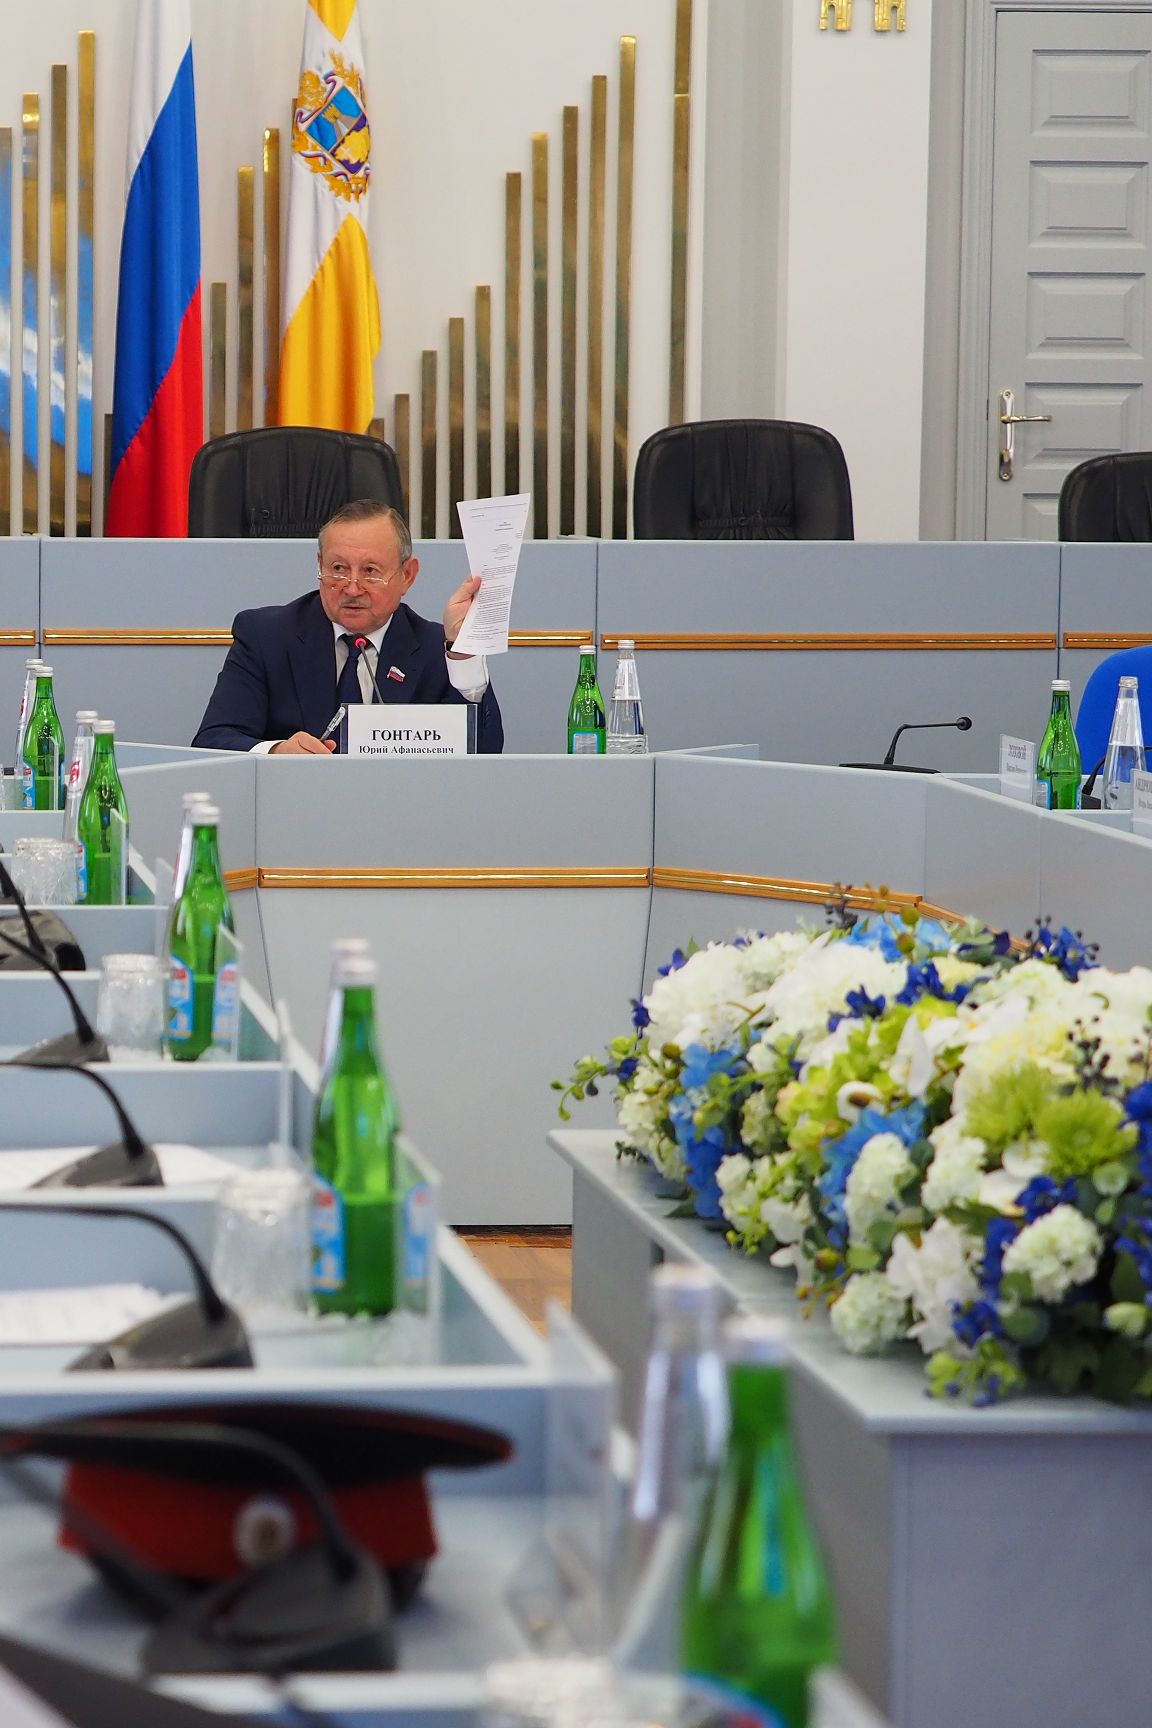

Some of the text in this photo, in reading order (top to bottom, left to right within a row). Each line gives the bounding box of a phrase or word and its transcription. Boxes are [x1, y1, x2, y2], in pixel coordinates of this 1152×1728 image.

[371, 729, 442, 741] ГОНТАРЬ
[359, 745, 454, 755] Юрий Афанасьевич
